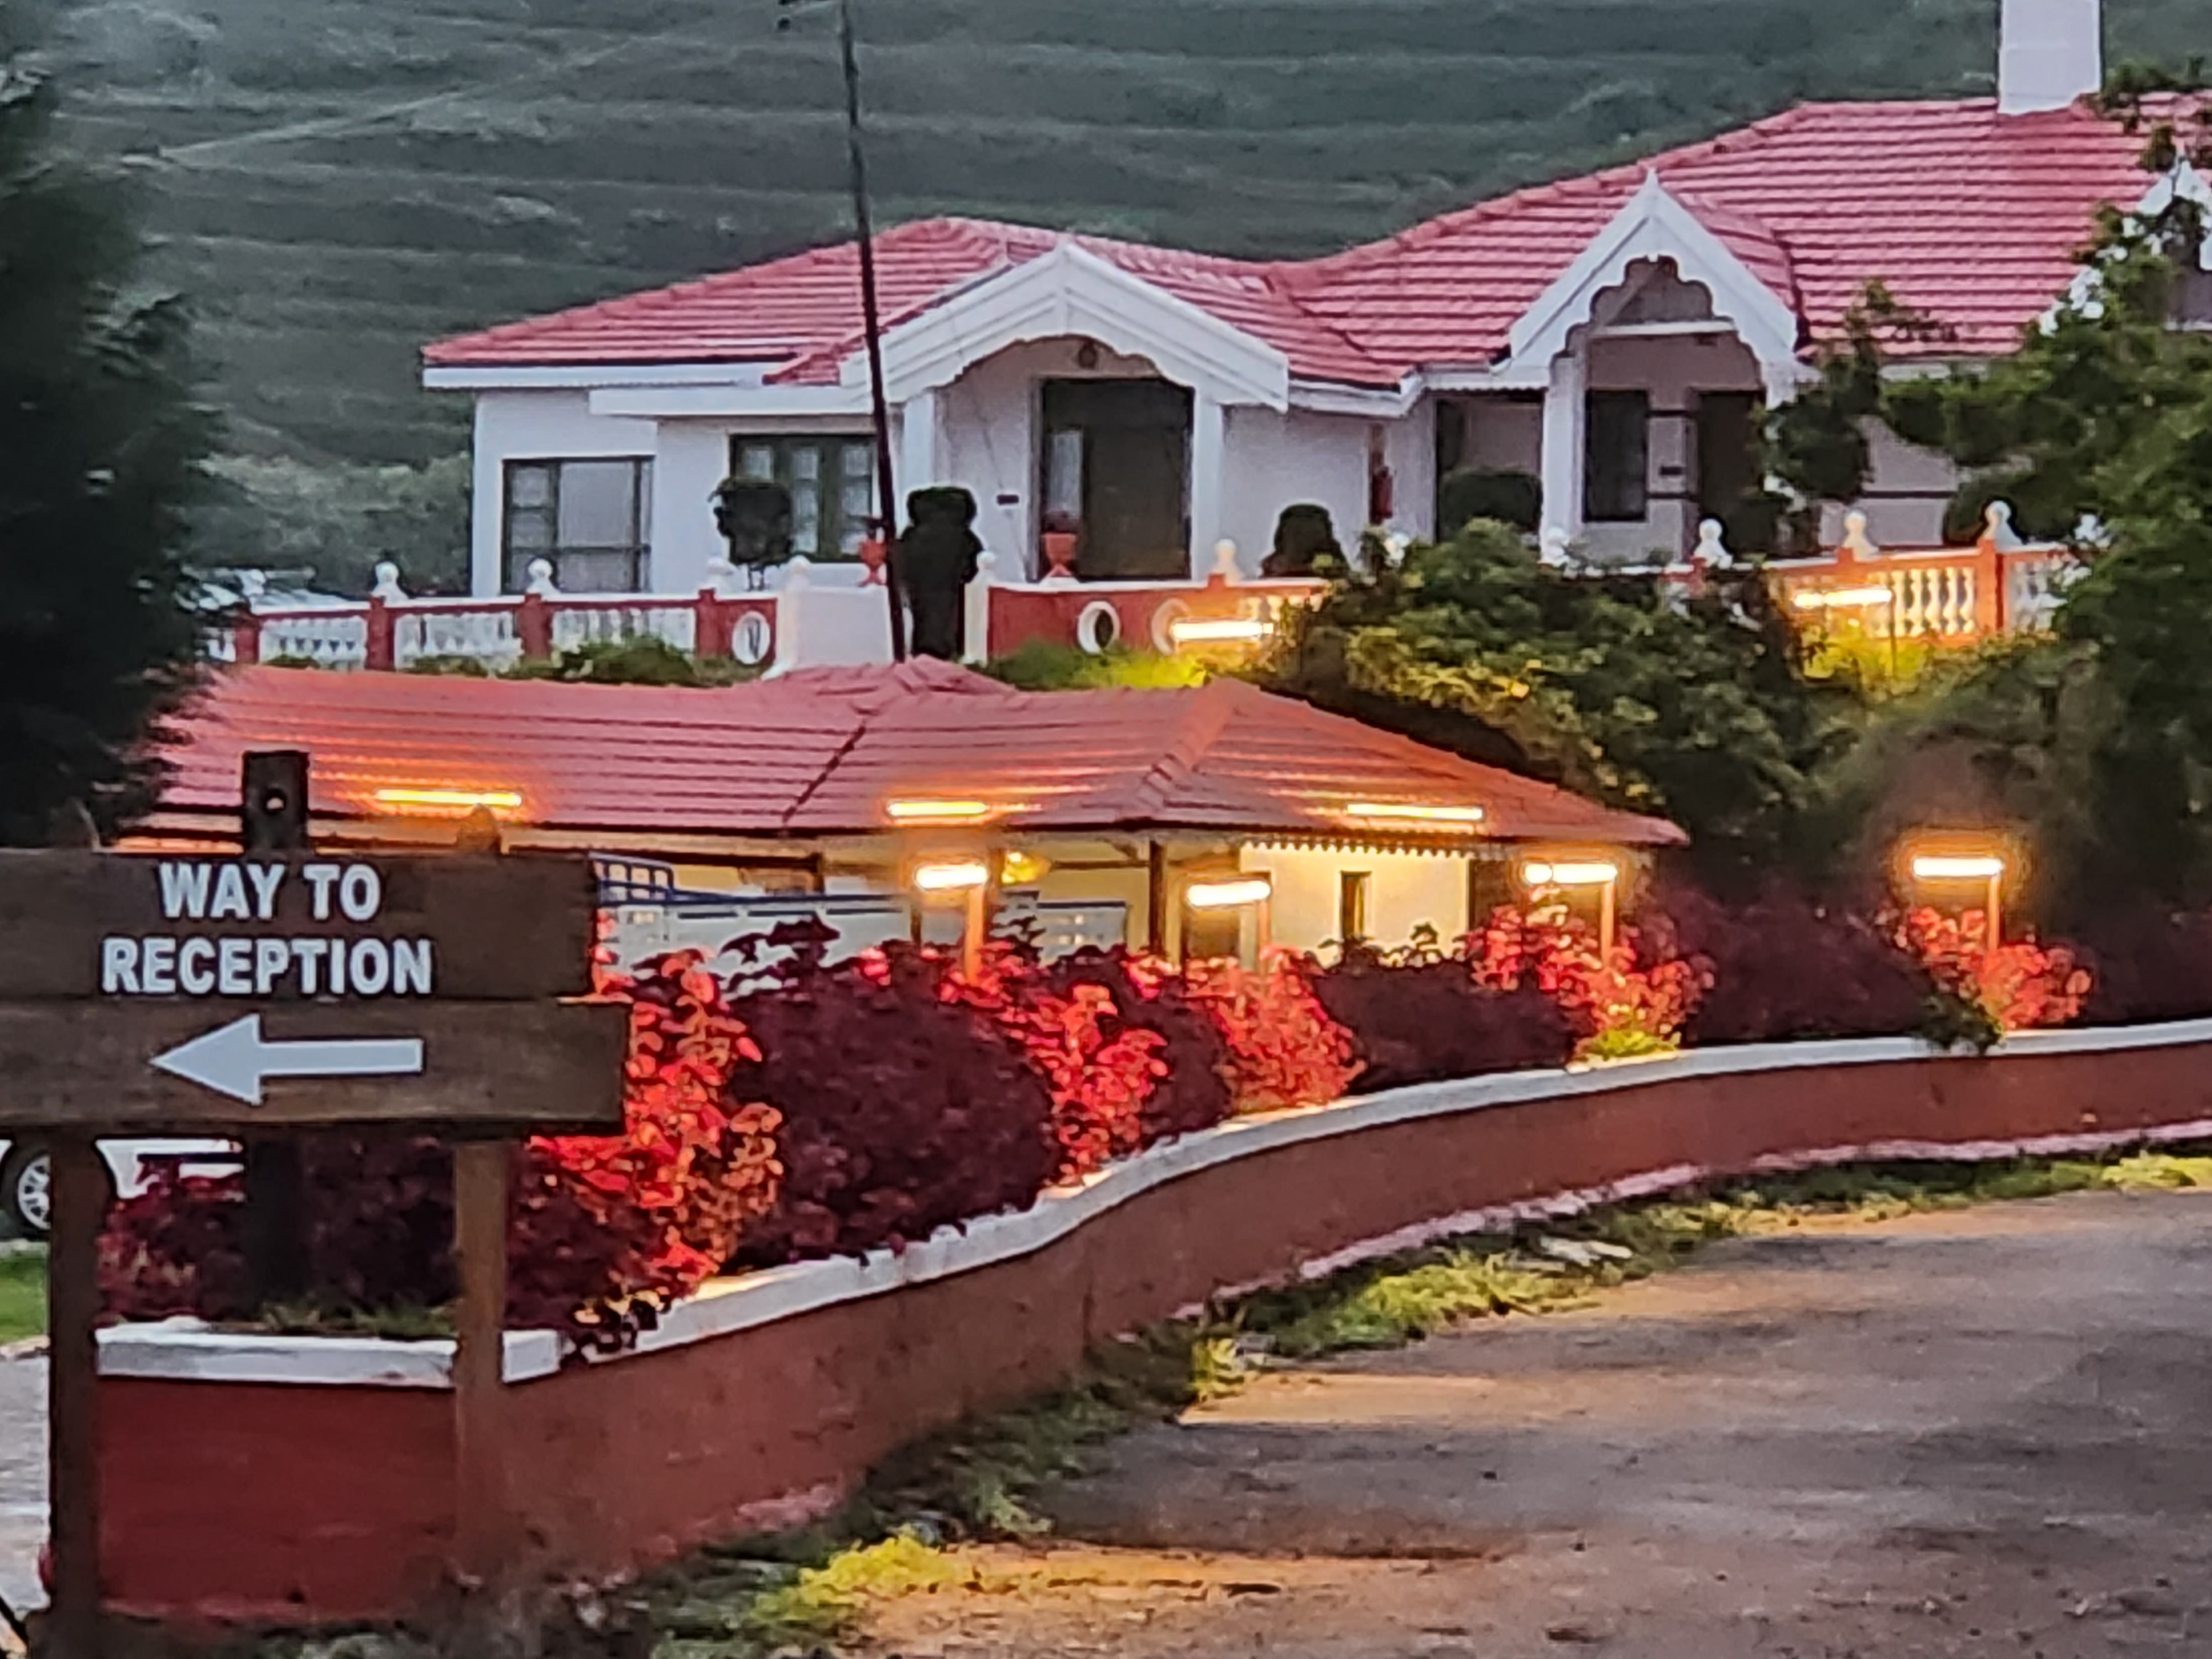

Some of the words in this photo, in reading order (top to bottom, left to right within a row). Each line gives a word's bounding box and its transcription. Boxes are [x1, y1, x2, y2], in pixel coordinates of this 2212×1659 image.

[161, 864, 284, 918] WAY
[304, 865, 379, 919] TO
[104, 938, 430, 993] RECEPTION
